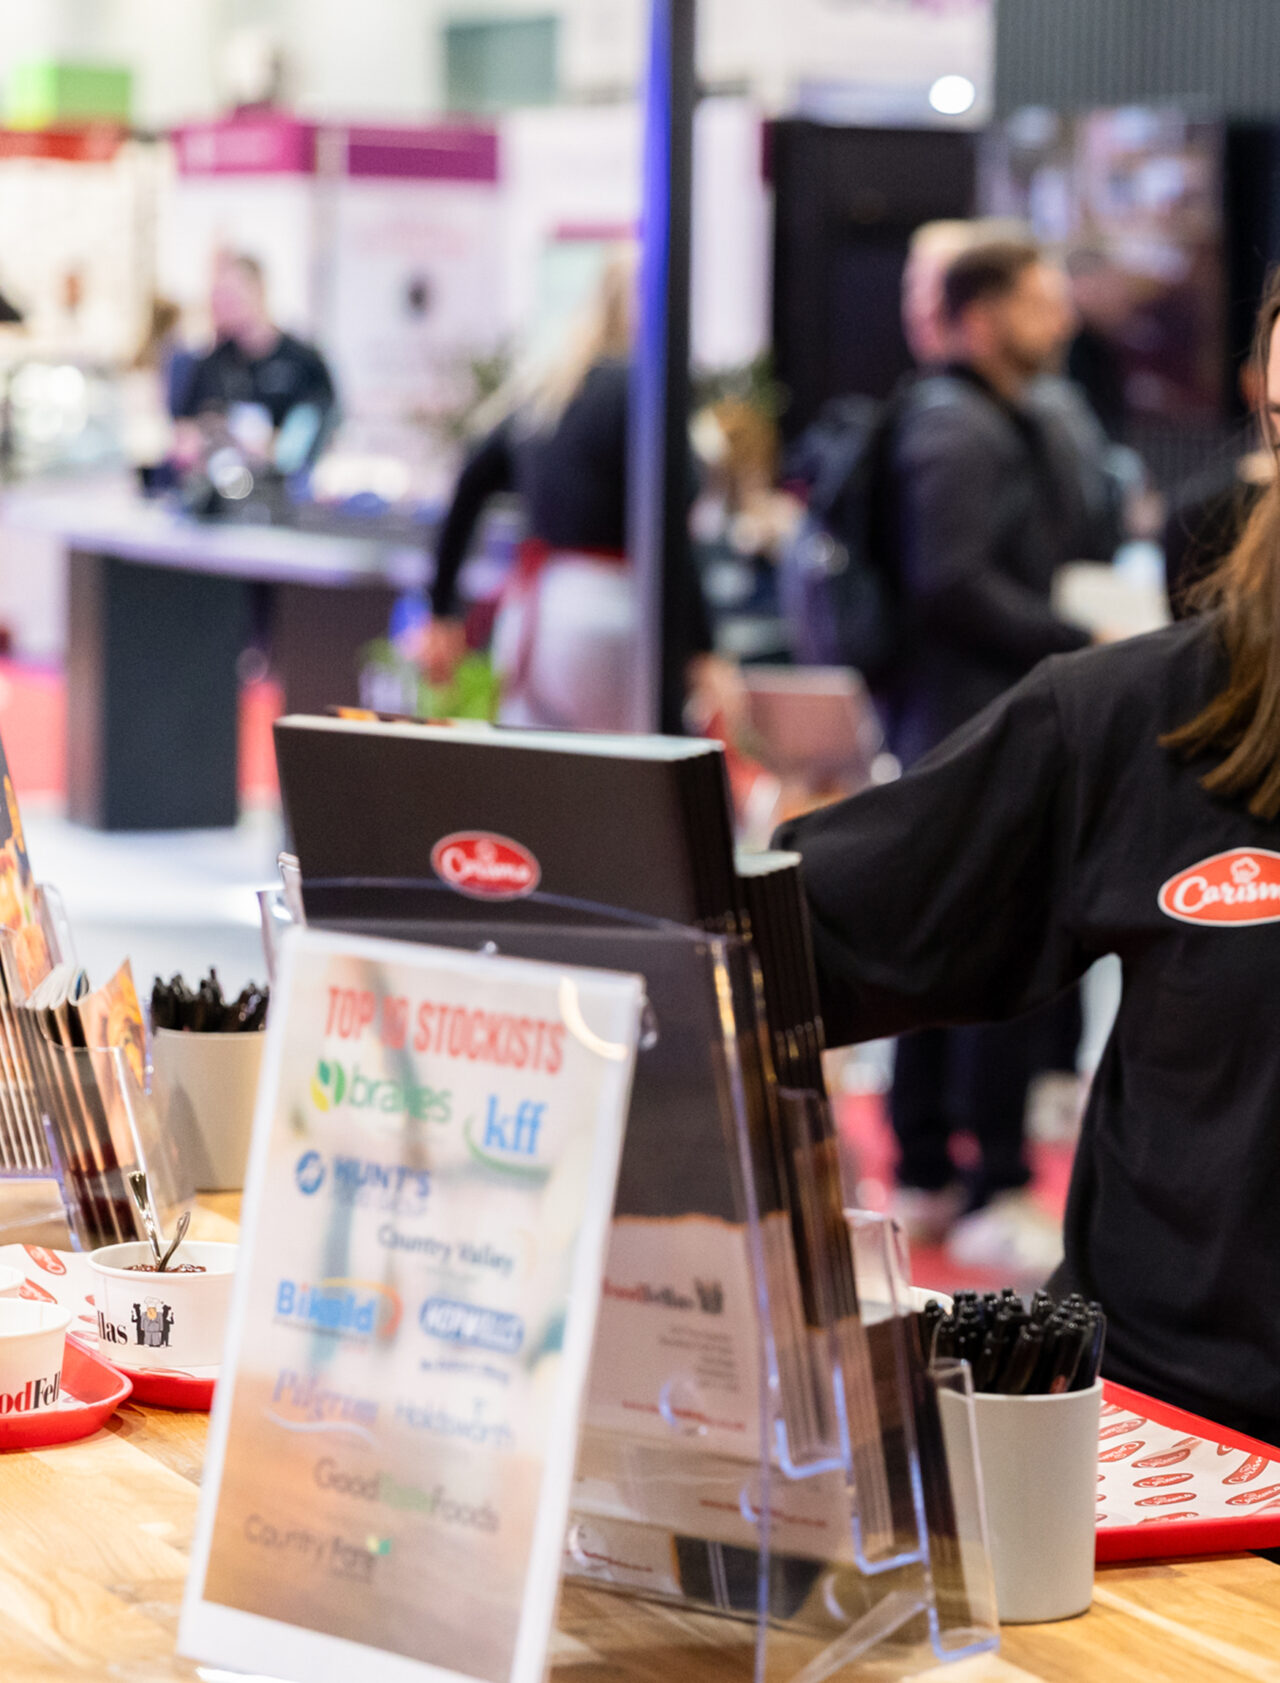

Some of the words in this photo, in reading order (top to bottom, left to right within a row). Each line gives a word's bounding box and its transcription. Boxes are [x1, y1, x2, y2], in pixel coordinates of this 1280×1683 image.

[325, 986, 376, 1040] TOP
[414, 1001, 566, 1076] STOCKISTS
[484, 1094, 548, 1154] kff
